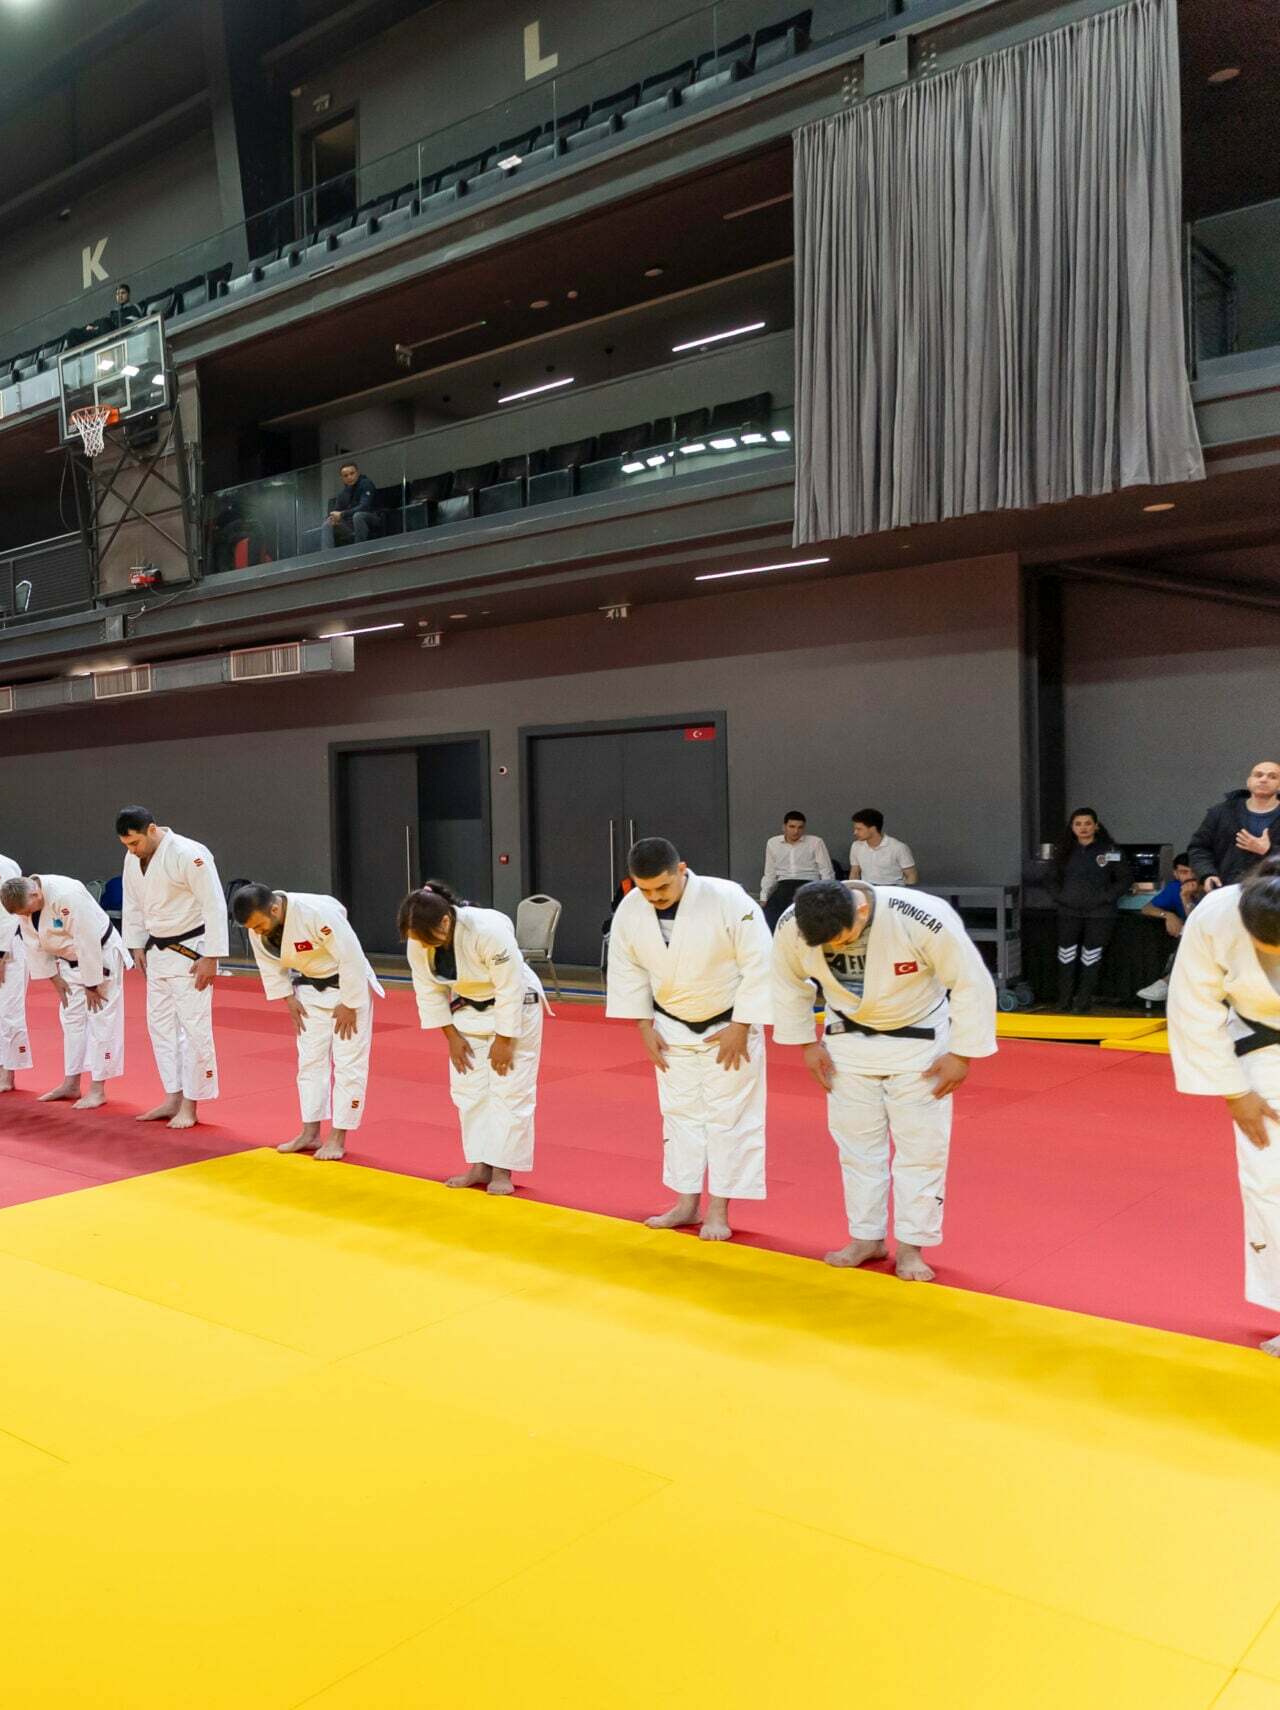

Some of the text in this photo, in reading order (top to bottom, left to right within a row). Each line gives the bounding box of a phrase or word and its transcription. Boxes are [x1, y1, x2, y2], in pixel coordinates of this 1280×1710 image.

[524, 20, 558, 81] L
[82, 236, 109, 289] K
[888, 897, 943, 934] IPPONGEAR
